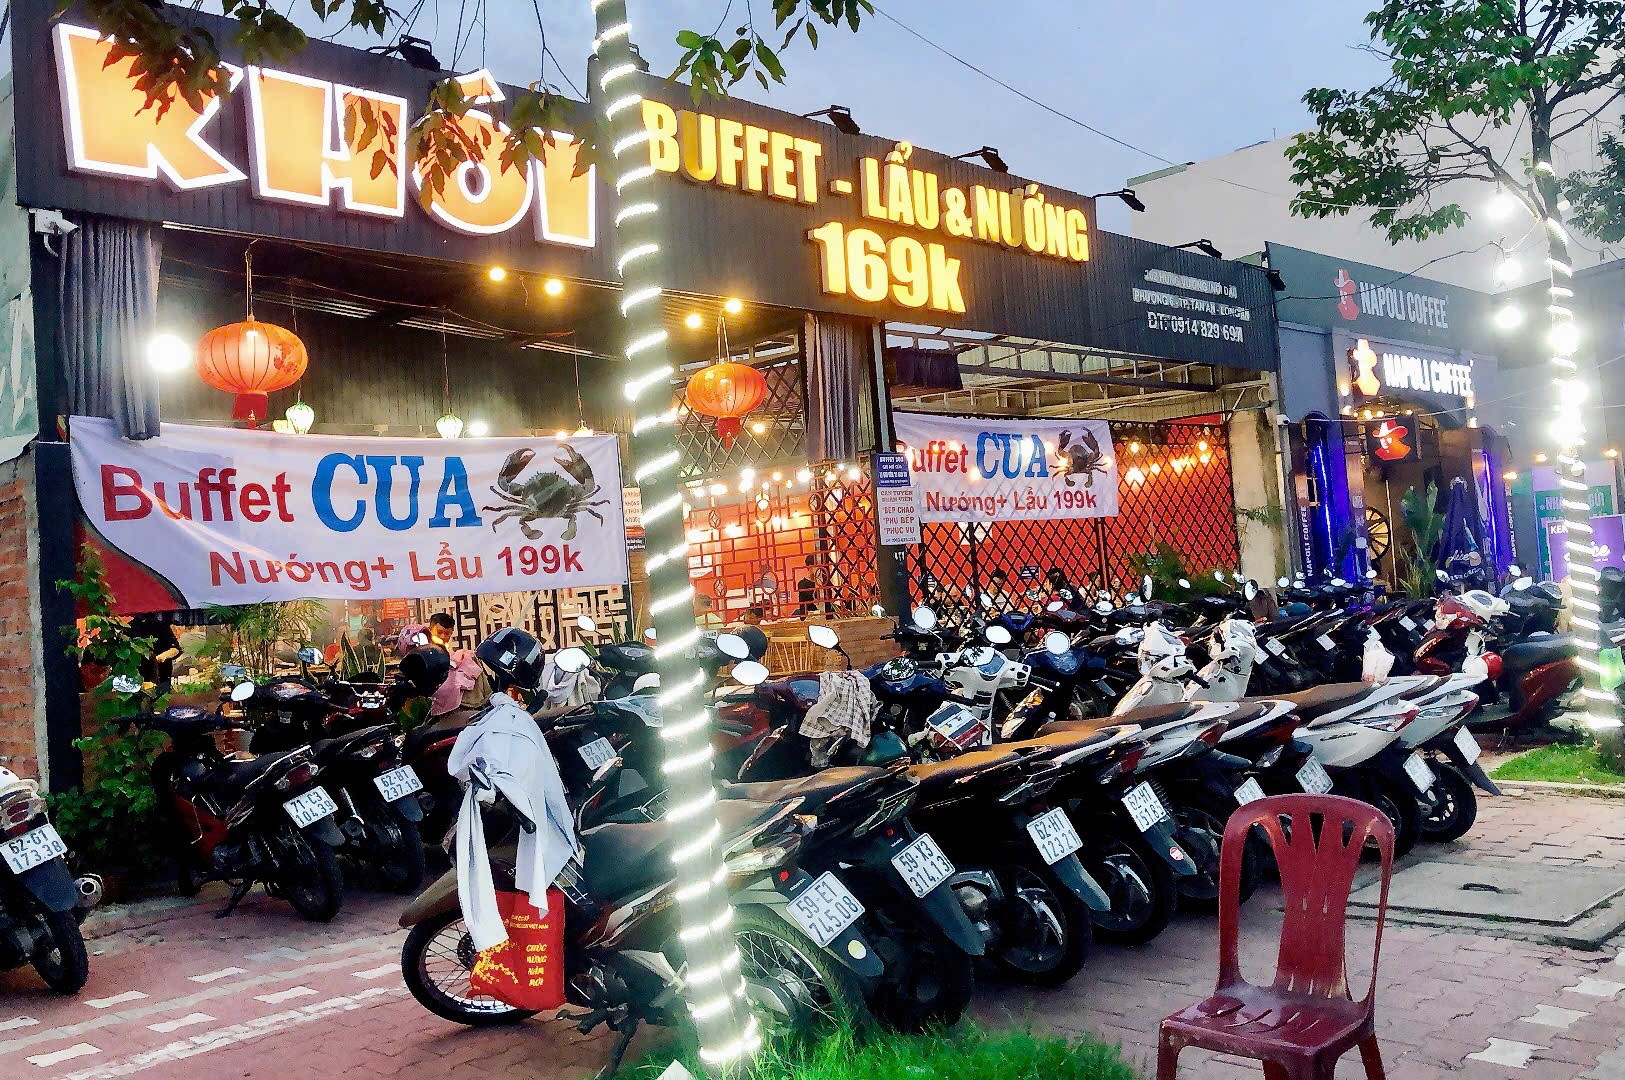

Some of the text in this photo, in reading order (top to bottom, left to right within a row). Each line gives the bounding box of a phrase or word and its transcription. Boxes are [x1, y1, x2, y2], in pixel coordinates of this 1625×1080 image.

[52, 22, 597, 248] KHÔI
[641, 99, 821, 204] BUFFET
[1360, 281, 1449, 328] NAPOLI COFFEE
[1171, 316, 1199, 336] 0914
[1200, 320, 1220, 339] 829
[1383, 352, 1473, 396] NAPOLI COFFEE
[976, 431, 1049, 480] CUA
[100, 452, 483, 533] Buffet CUA
[1014, 486, 1047, 511] Lẩu
[1054, 490, 1098, 510] 199k
[408, 542, 483, 582] Lẩu
[496, 543, 585, 578] 199k
[1304, 543, 1313, 577] NAPOLI
[290, 791, 323, 813] 71-C3
[384, 779, 420, 801] 237.19
[296, 800, 334, 826] 104.39
[1034, 814, 1065, 840] 62-H1
[12, 840, 63, 870] 173.38
[900, 840, 934, 873] 59-X3
[910, 855, 951, 894] 314.13
[796, 881, 838, 919] 59-E1
[809, 896, 859, 943] 745.08
